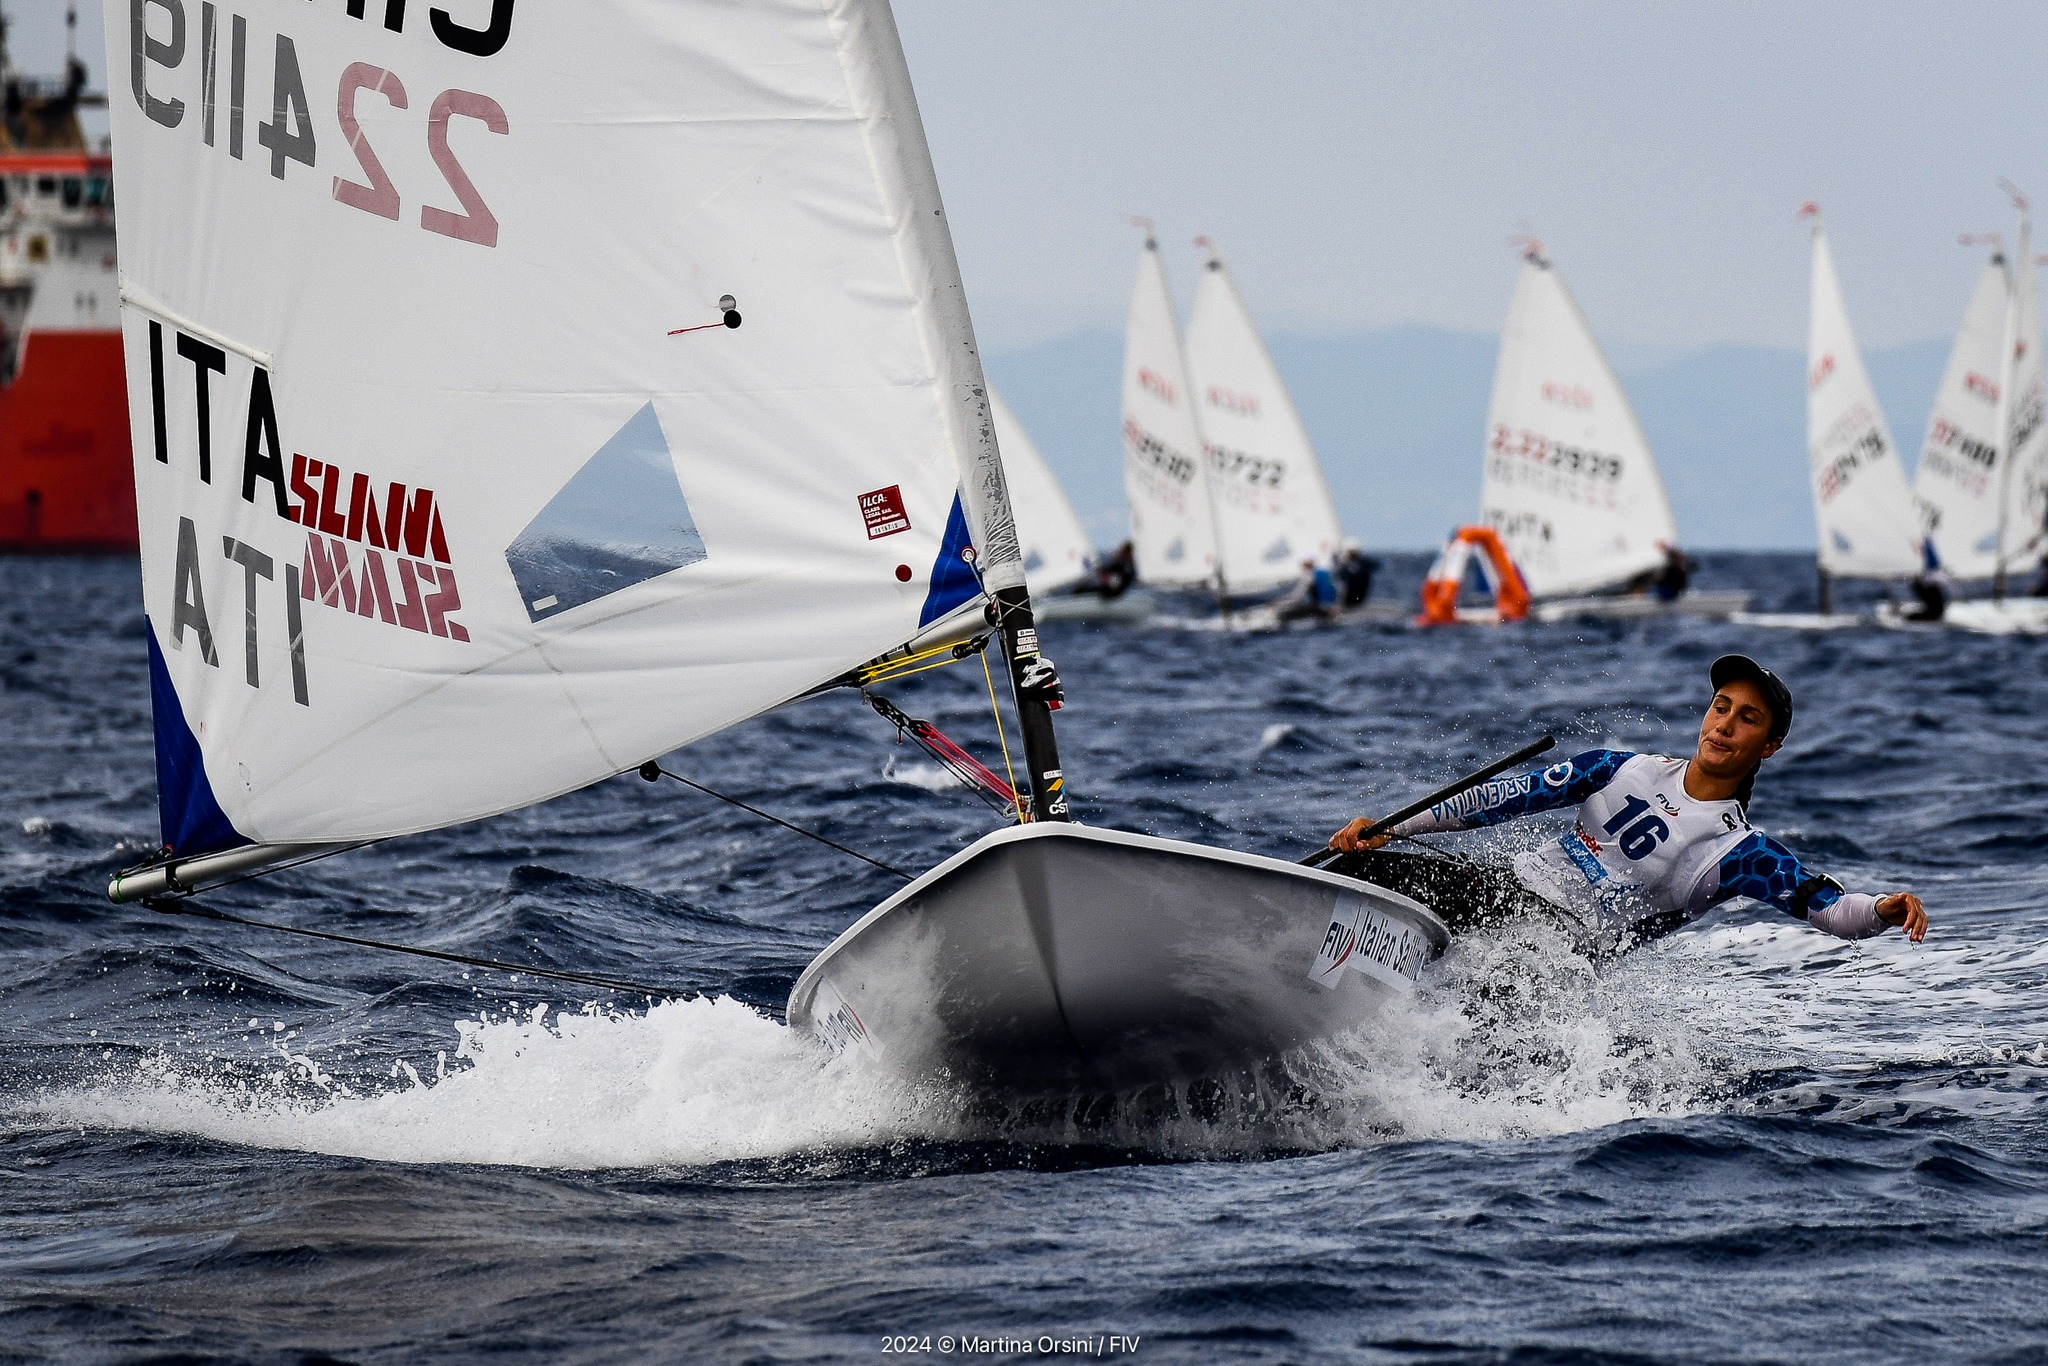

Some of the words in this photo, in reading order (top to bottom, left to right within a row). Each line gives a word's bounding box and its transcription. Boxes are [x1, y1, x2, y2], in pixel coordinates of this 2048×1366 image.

[149, 319, 301, 523] ITA
[1602, 794, 1670, 861] 16
[1656, 793, 1675, 811] FIV
[1320, 921, 1351, 961] FIV
[1355, 911, 1397, 967] Italian
